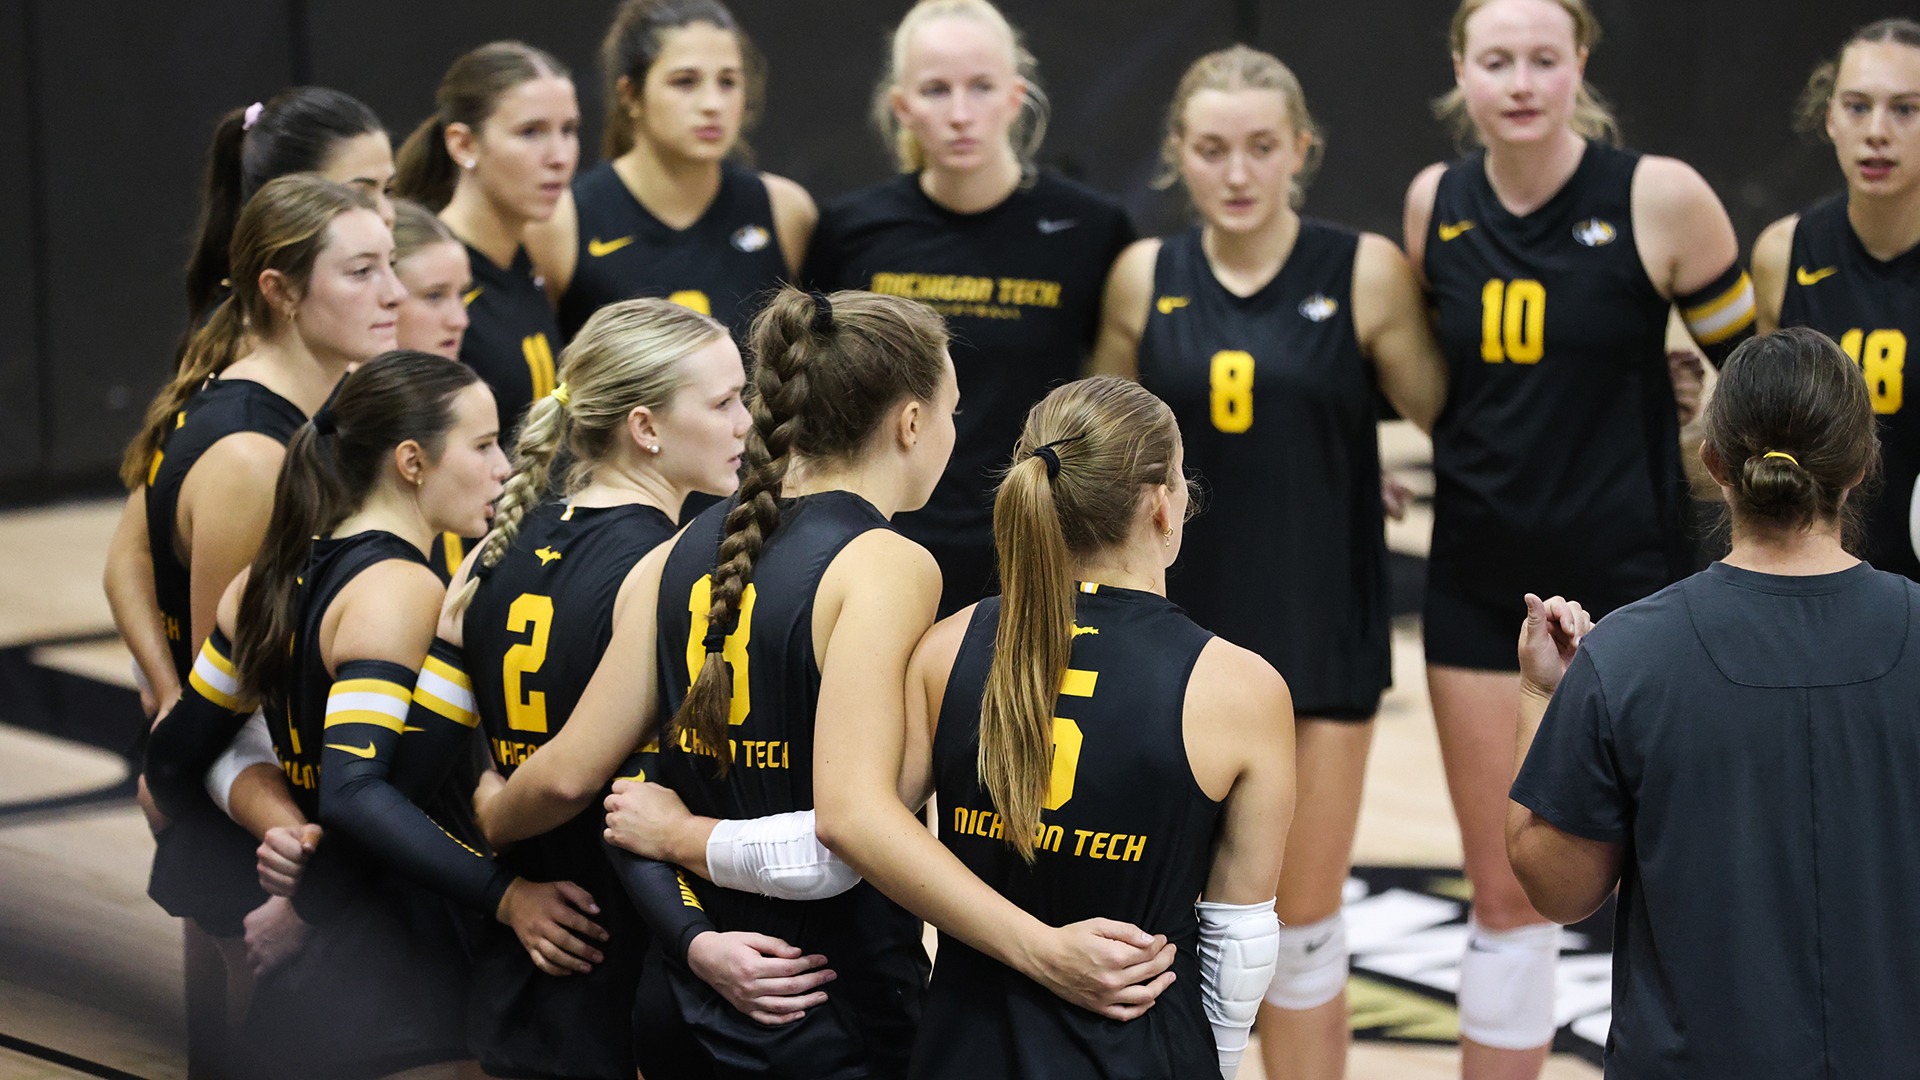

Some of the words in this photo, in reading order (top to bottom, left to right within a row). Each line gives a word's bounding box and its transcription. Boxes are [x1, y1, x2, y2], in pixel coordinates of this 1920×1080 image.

[871, 272, 994, 302] MICHIGAN
[998, 277, 1063, 309] TECH
[1481, 277, 1547, 365] 10
[1209, 349, 1256, 435] 8
[502, 592, 555, 734] 2
[742, 740, 790, 770] TECH
[1073, 828, 1148, 863] TECH
